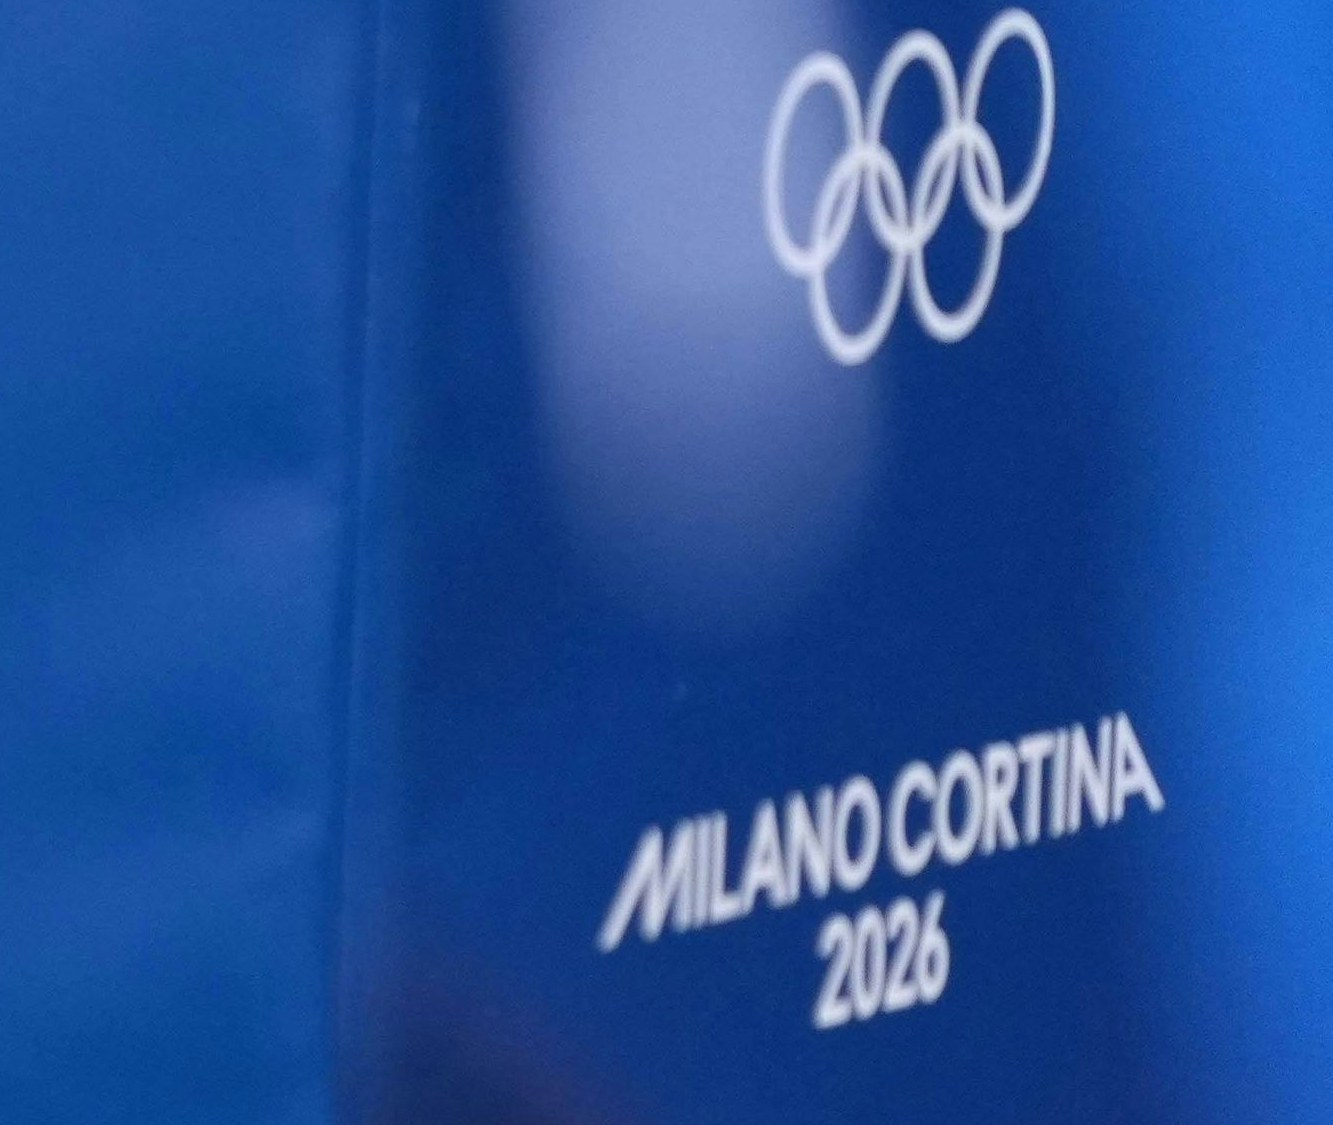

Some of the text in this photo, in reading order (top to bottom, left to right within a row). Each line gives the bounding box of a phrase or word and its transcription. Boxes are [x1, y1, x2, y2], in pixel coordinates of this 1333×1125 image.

[595, 709, 1166, 954] MILANO CORTINA
[812, 888, 951, 1030] 2026
